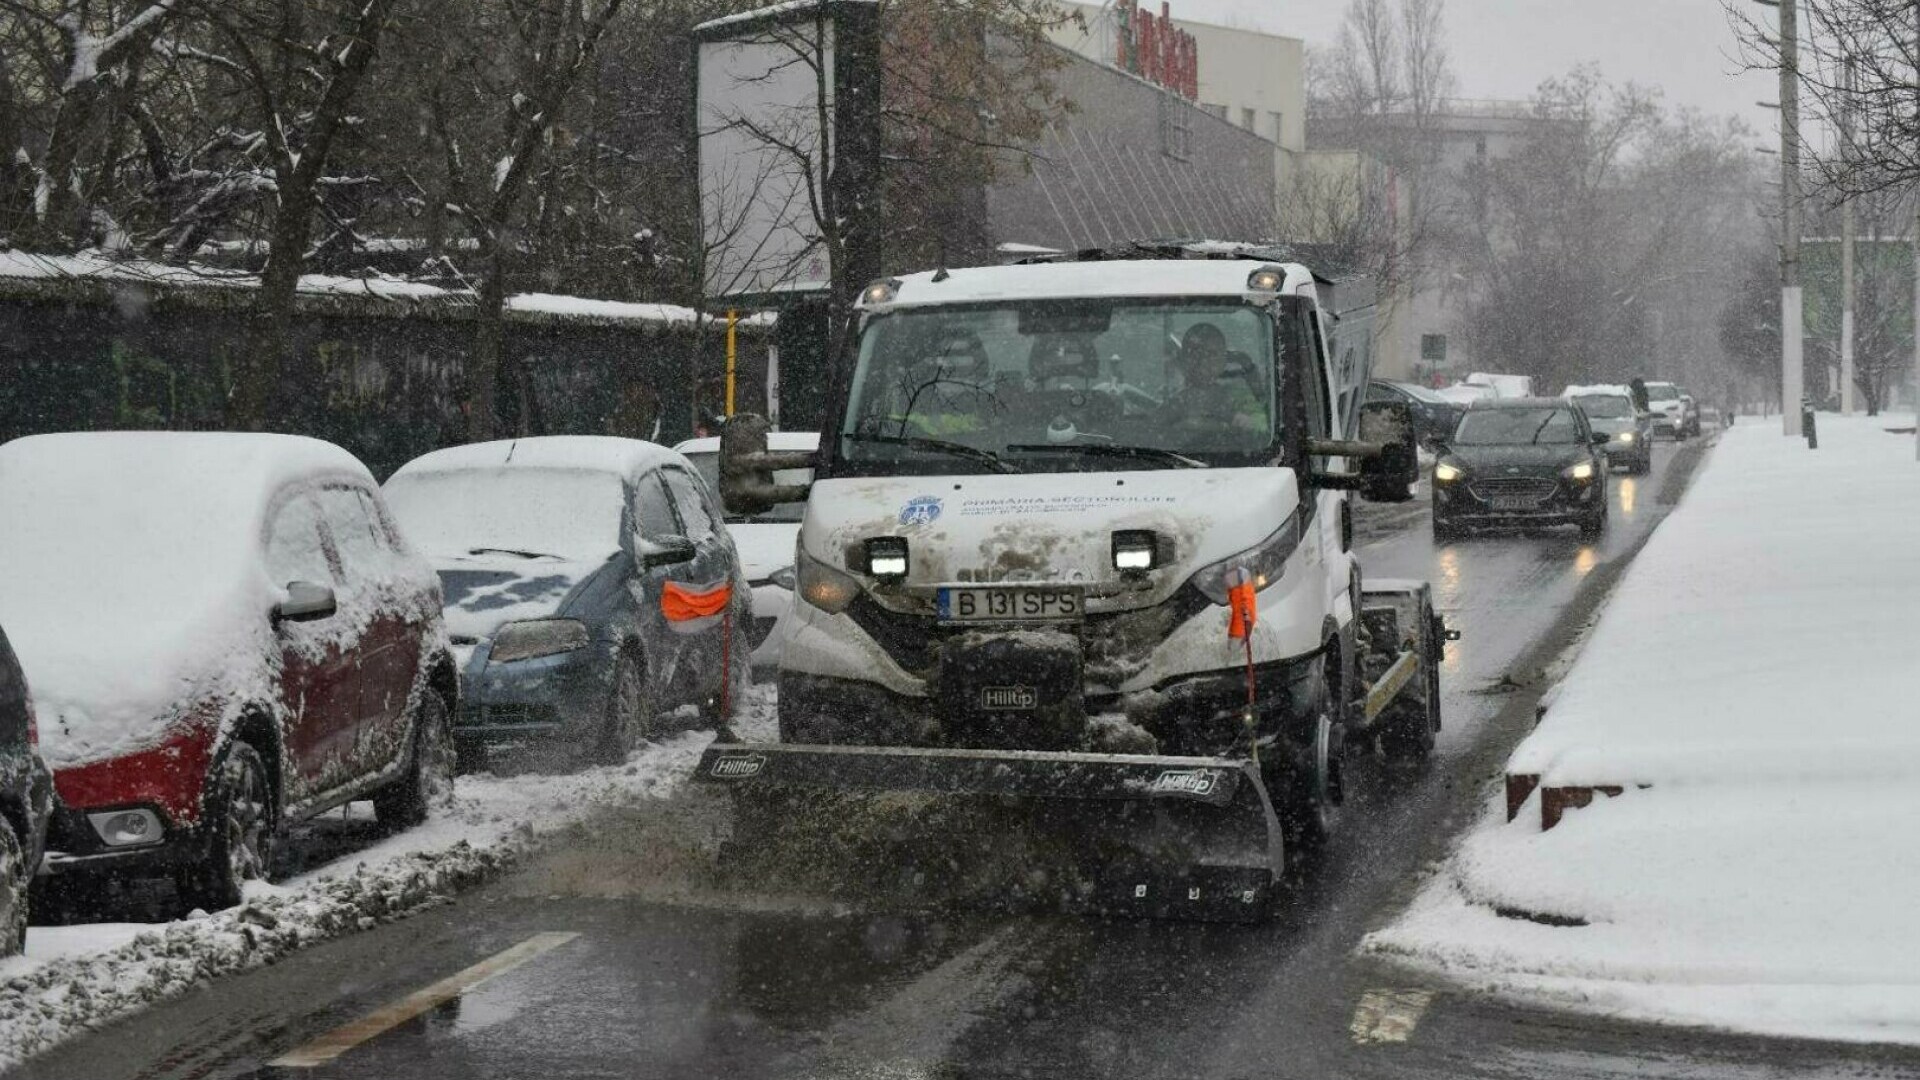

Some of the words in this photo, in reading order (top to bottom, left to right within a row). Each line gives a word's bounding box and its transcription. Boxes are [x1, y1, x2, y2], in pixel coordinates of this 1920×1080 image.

[958, 592, 976, 615] B
[985, 591, 1016, 616] 131
[1023, 592, 1076, 614] SPS
[986, 689, 1033, 708] Hilltip
[717, 759, 760, 775] Hilltip
